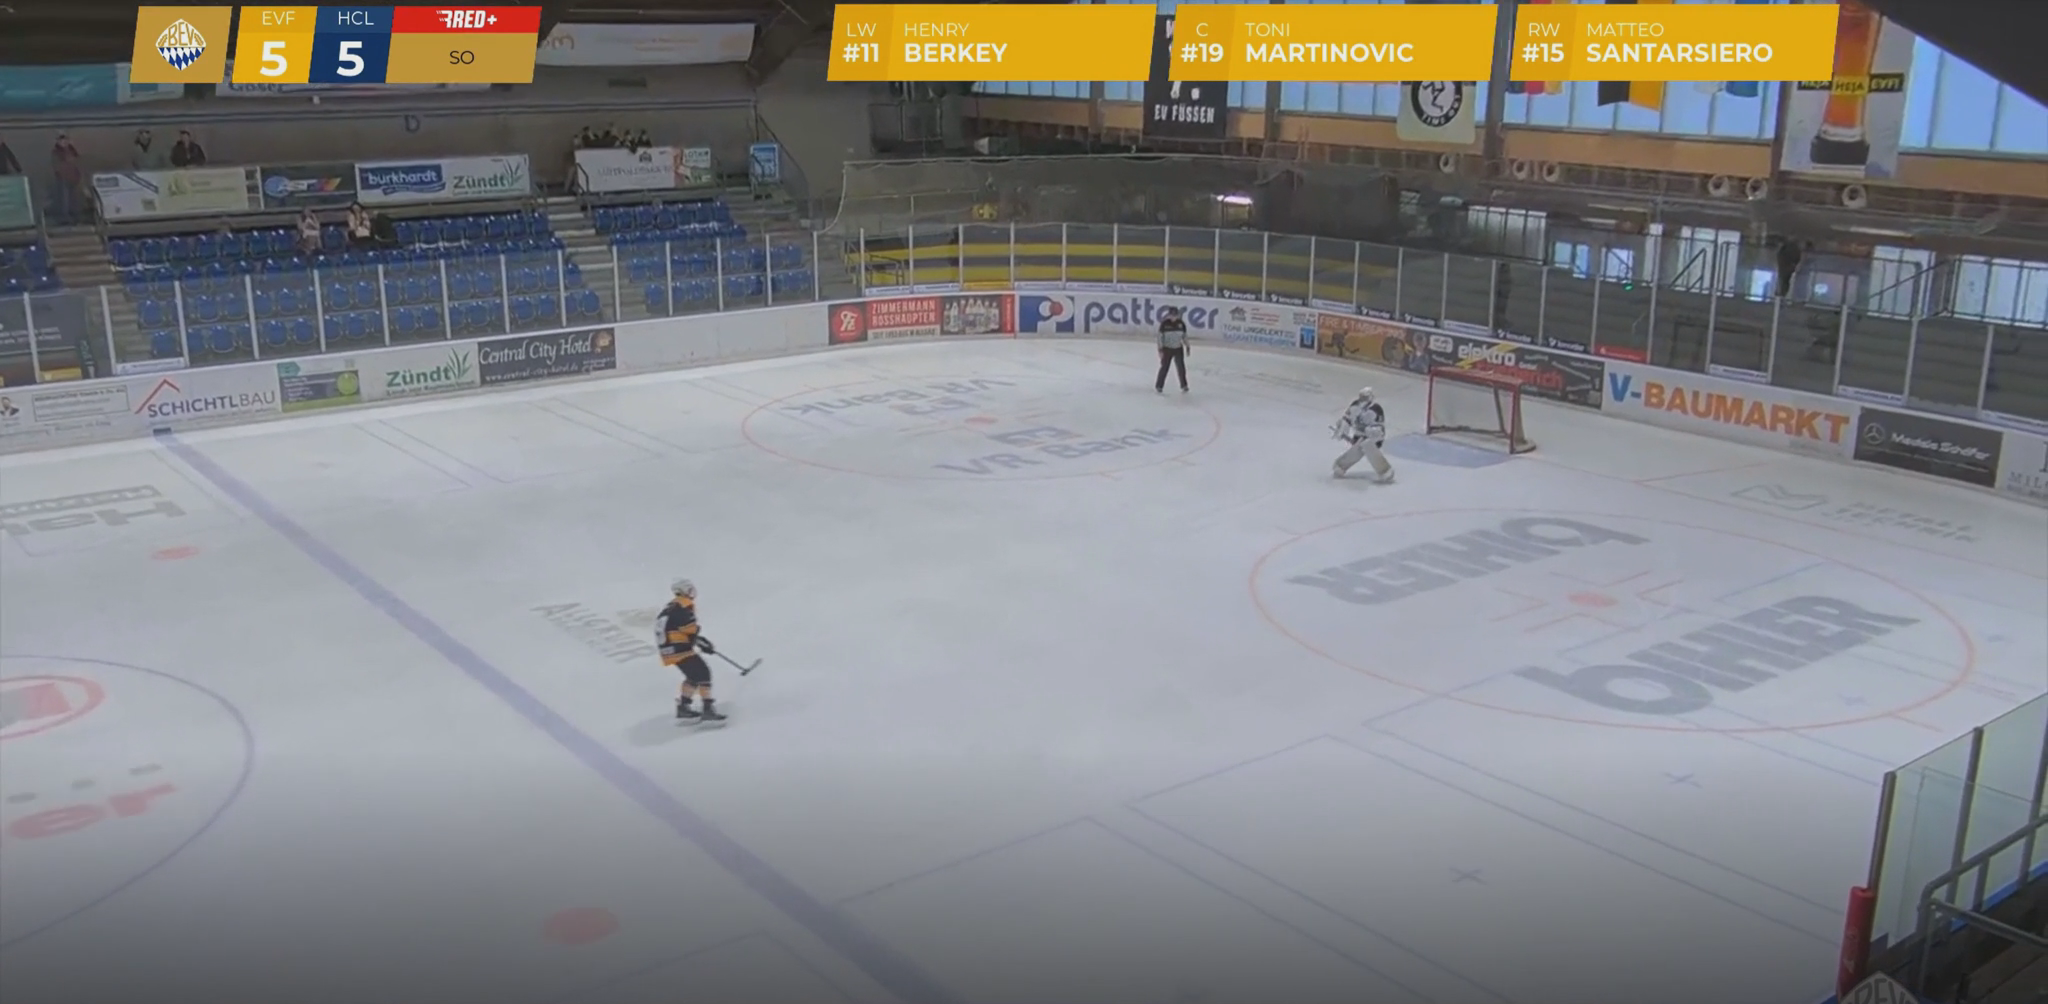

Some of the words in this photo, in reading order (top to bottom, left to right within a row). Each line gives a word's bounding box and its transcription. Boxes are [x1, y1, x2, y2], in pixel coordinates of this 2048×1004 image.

[1154, 104, 1169, 120] EV
[1172, 103, 1215, 123] FÜSSEN
[367, 169, 438, 185] burkhardt
[453, 172, 506, 189] Zündt
[872, 299, 936, 315] ZIMMERMANN
[872, 311, 936, 328] ROSSHAUPTEN
[479, 338, 530, 366] Central
[528, 341, 558, 366] City
[559, 331, 595, 356] Hotel
[385, 365, 452, 388] Zündt
[147, 389, 277, 419] SCHICHTLBAU
[1608, 371, 1850, 445] V-BAUMARKT
[930, 452, 1048, 476] VR
[1036, 427, 1194, 460] Bank
